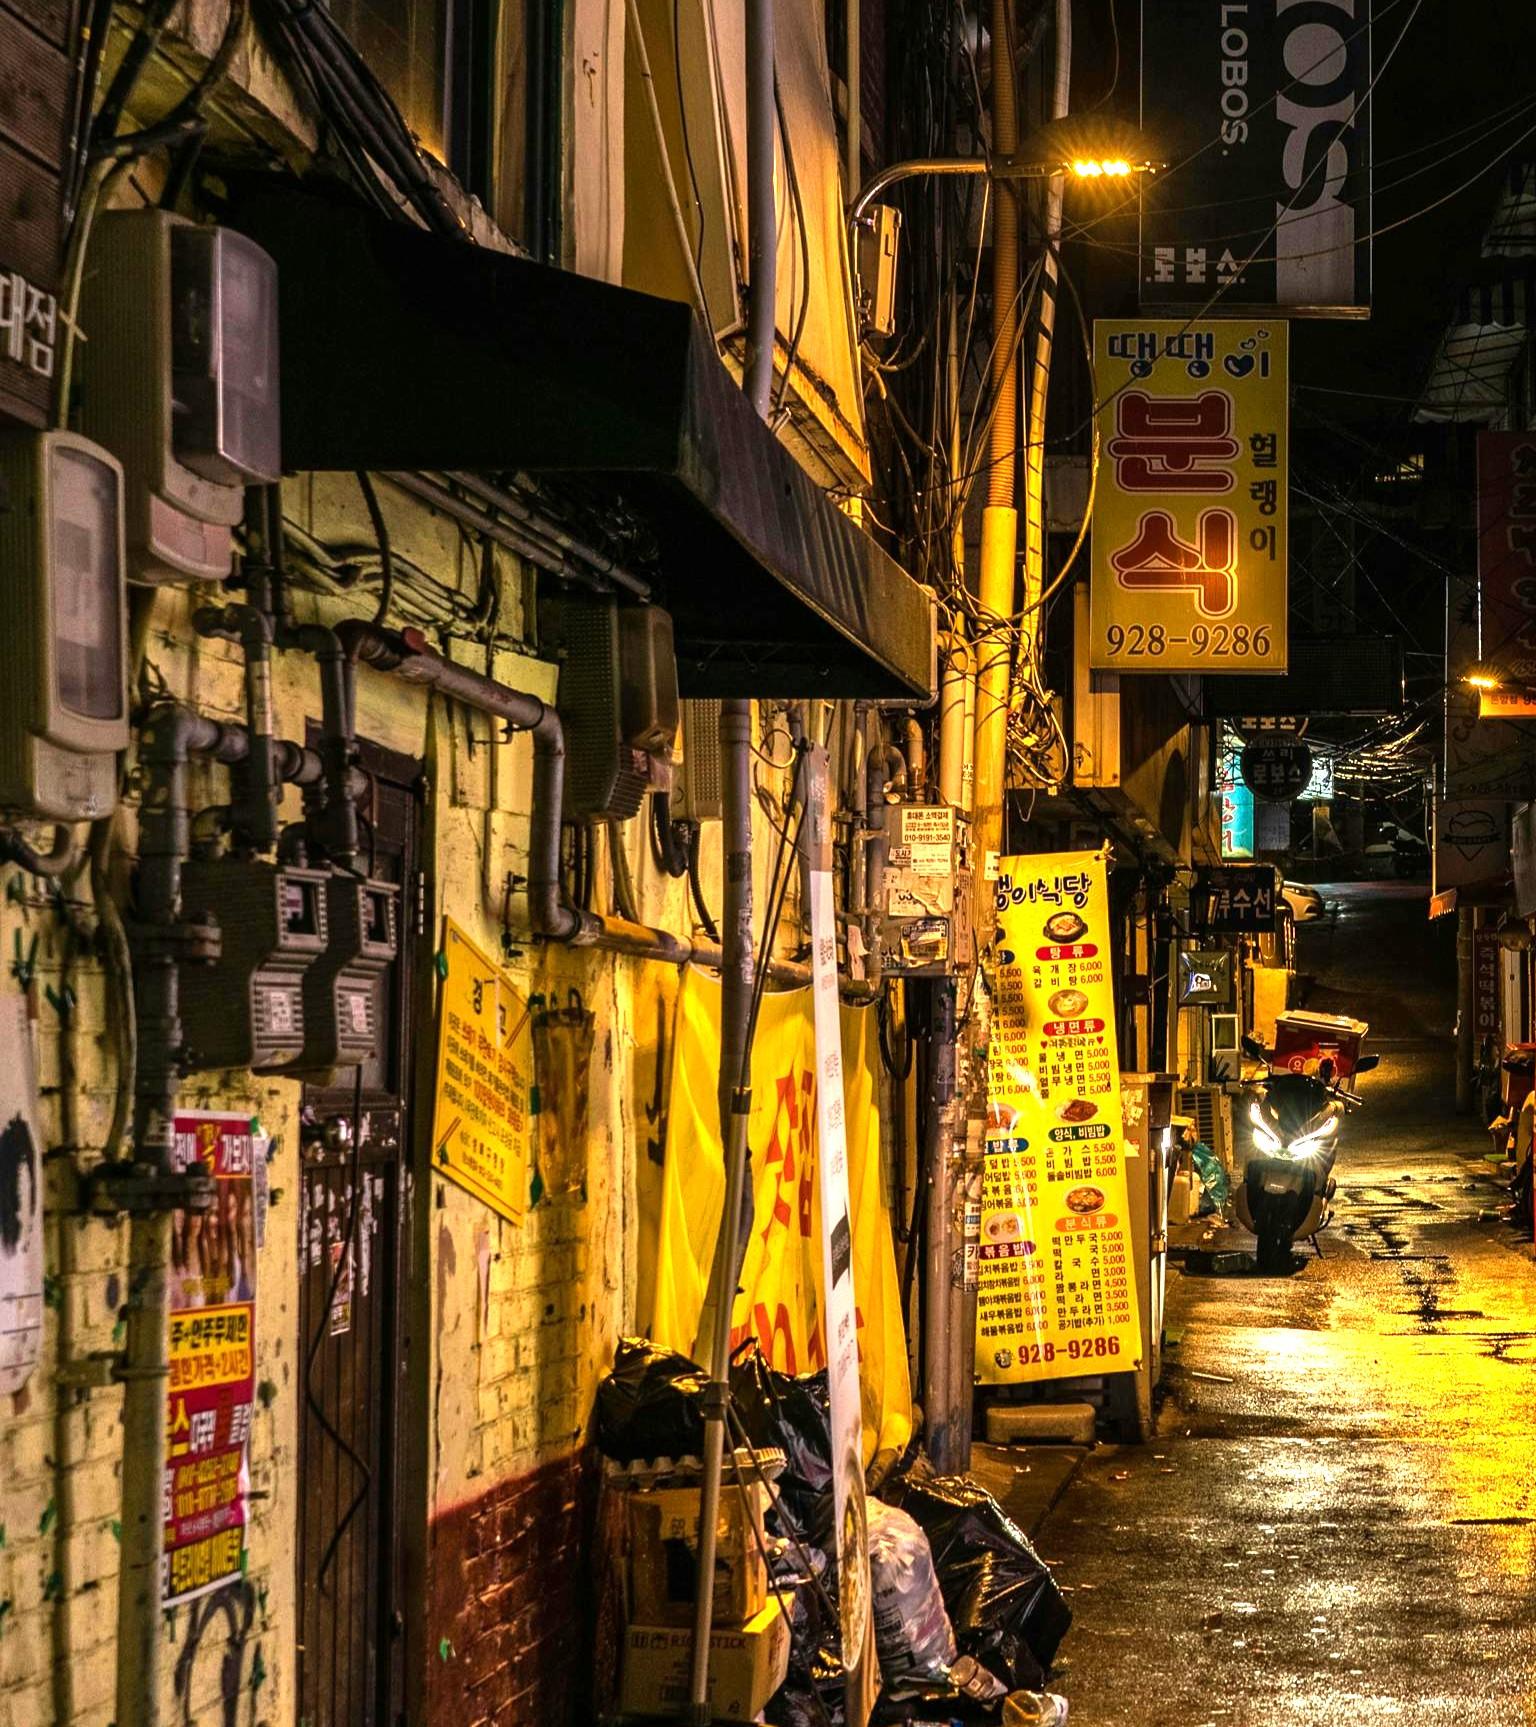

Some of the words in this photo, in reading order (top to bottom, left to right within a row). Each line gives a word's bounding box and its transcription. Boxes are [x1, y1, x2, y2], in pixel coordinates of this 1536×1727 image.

[1108, 332, 1270, 379] 땡땡이
[1249, 433, 1277, 560] 헐랭이
[1107, 389, 1240, 620] 분식
[1106, 624, 1273, 657] 928-9286
[1253, 762, 1302, 784] 로보스
[904, 833, 951, 842] 010-9191-3540
[1050, 947, 1084, 959] 탕류
[1080, 961, 1102, 971] 6,000
[1080, 974, 1103, 984] 6,000
[1053, 1020, 1095, 1035] 냉면류
[1004, 1031, 1026, 1042] 6,000
[1087, 1048, 1108, 1058] 5,000
[1039, 1062, 1084, 1075] 비빔냉면
[1088, 1060, 1110, 1071] 5,000
[1089, 1073, 1110, 1083] 5,500
[1078, 1125, 1105, 1139] 비빔밥
[1094, 1143, 1115, 1153] 5,500
[1046, 1156, 1091, 1169] 비빔밥
[1094, 1155, 1116, 1164] 5,500
[1096, 1167, 1117, 1177] 6,000
[1065, 1216, 1107, 1230] 분식류
[1052, 1233, 1097, 1246] 떡만두국
[1101, 1231, 1123, 1241] 5,000
[1102, 1243, 1124, 1253] 5,000
[1054, 1257, 1099, 1271] 칼국수
[1103, 1254, 1125, 1264] 5,000
[1104, 1266, 1126, 1276] 3,000
[1105, 1278, 1127, 1288] 4,500
[1057, 1291, 1102, 1305] 떡라면
[1106, 1290, 1127, 1300] 3,500
[1057, 1303, 1103, 1318] 만두라면
[1107, 1302, 1128, 1312] 3,500
[1108, 1314, 1130, 1324] 1,000
[1017, 1336, 1121, 1365] 928-9286
